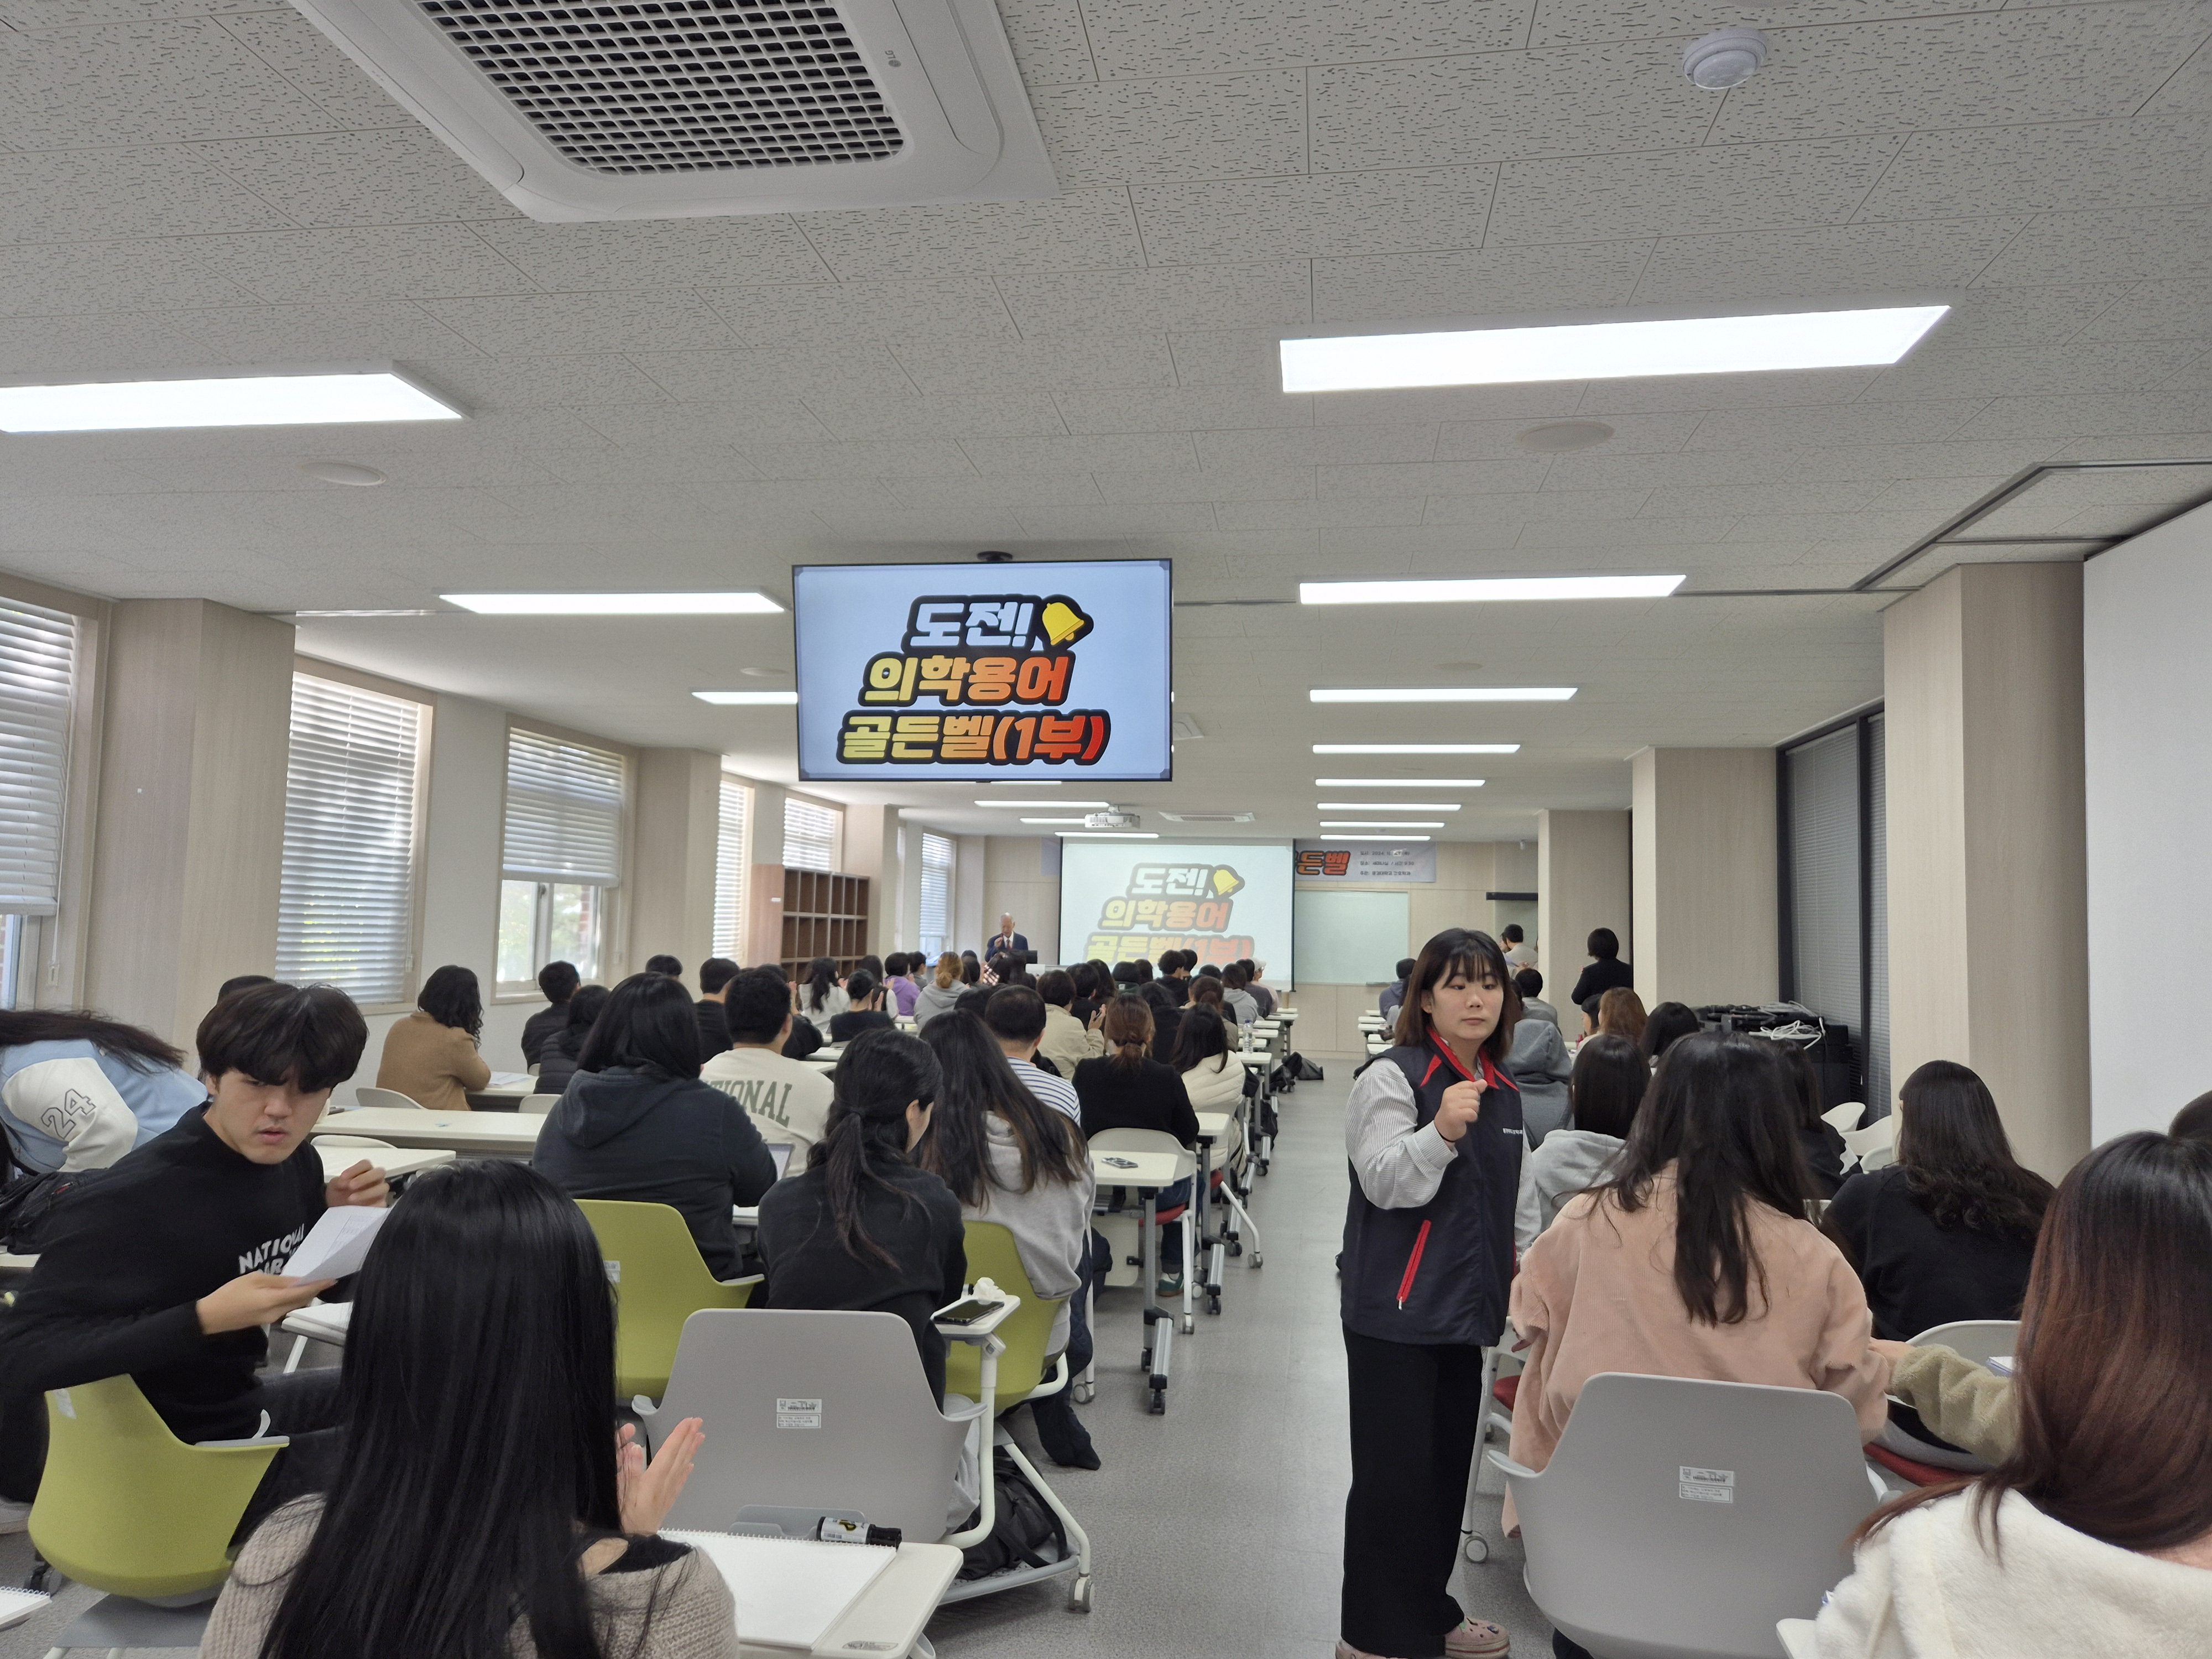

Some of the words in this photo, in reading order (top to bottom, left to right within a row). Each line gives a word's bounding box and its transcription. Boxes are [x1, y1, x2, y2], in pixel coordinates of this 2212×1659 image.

[909, 599, 1035, 648] 도전!
[863, 654, 1070, 703] 의학용어
[842, 714, 1105, 760] 골든벨(1부)
[1130, 866, 1208, 896] 도전!
[1295, 851, 1350, 875] 든벨
[1102, 898, 1230, 930] 의학용어
[40, 1088, 97, 1140] 24
